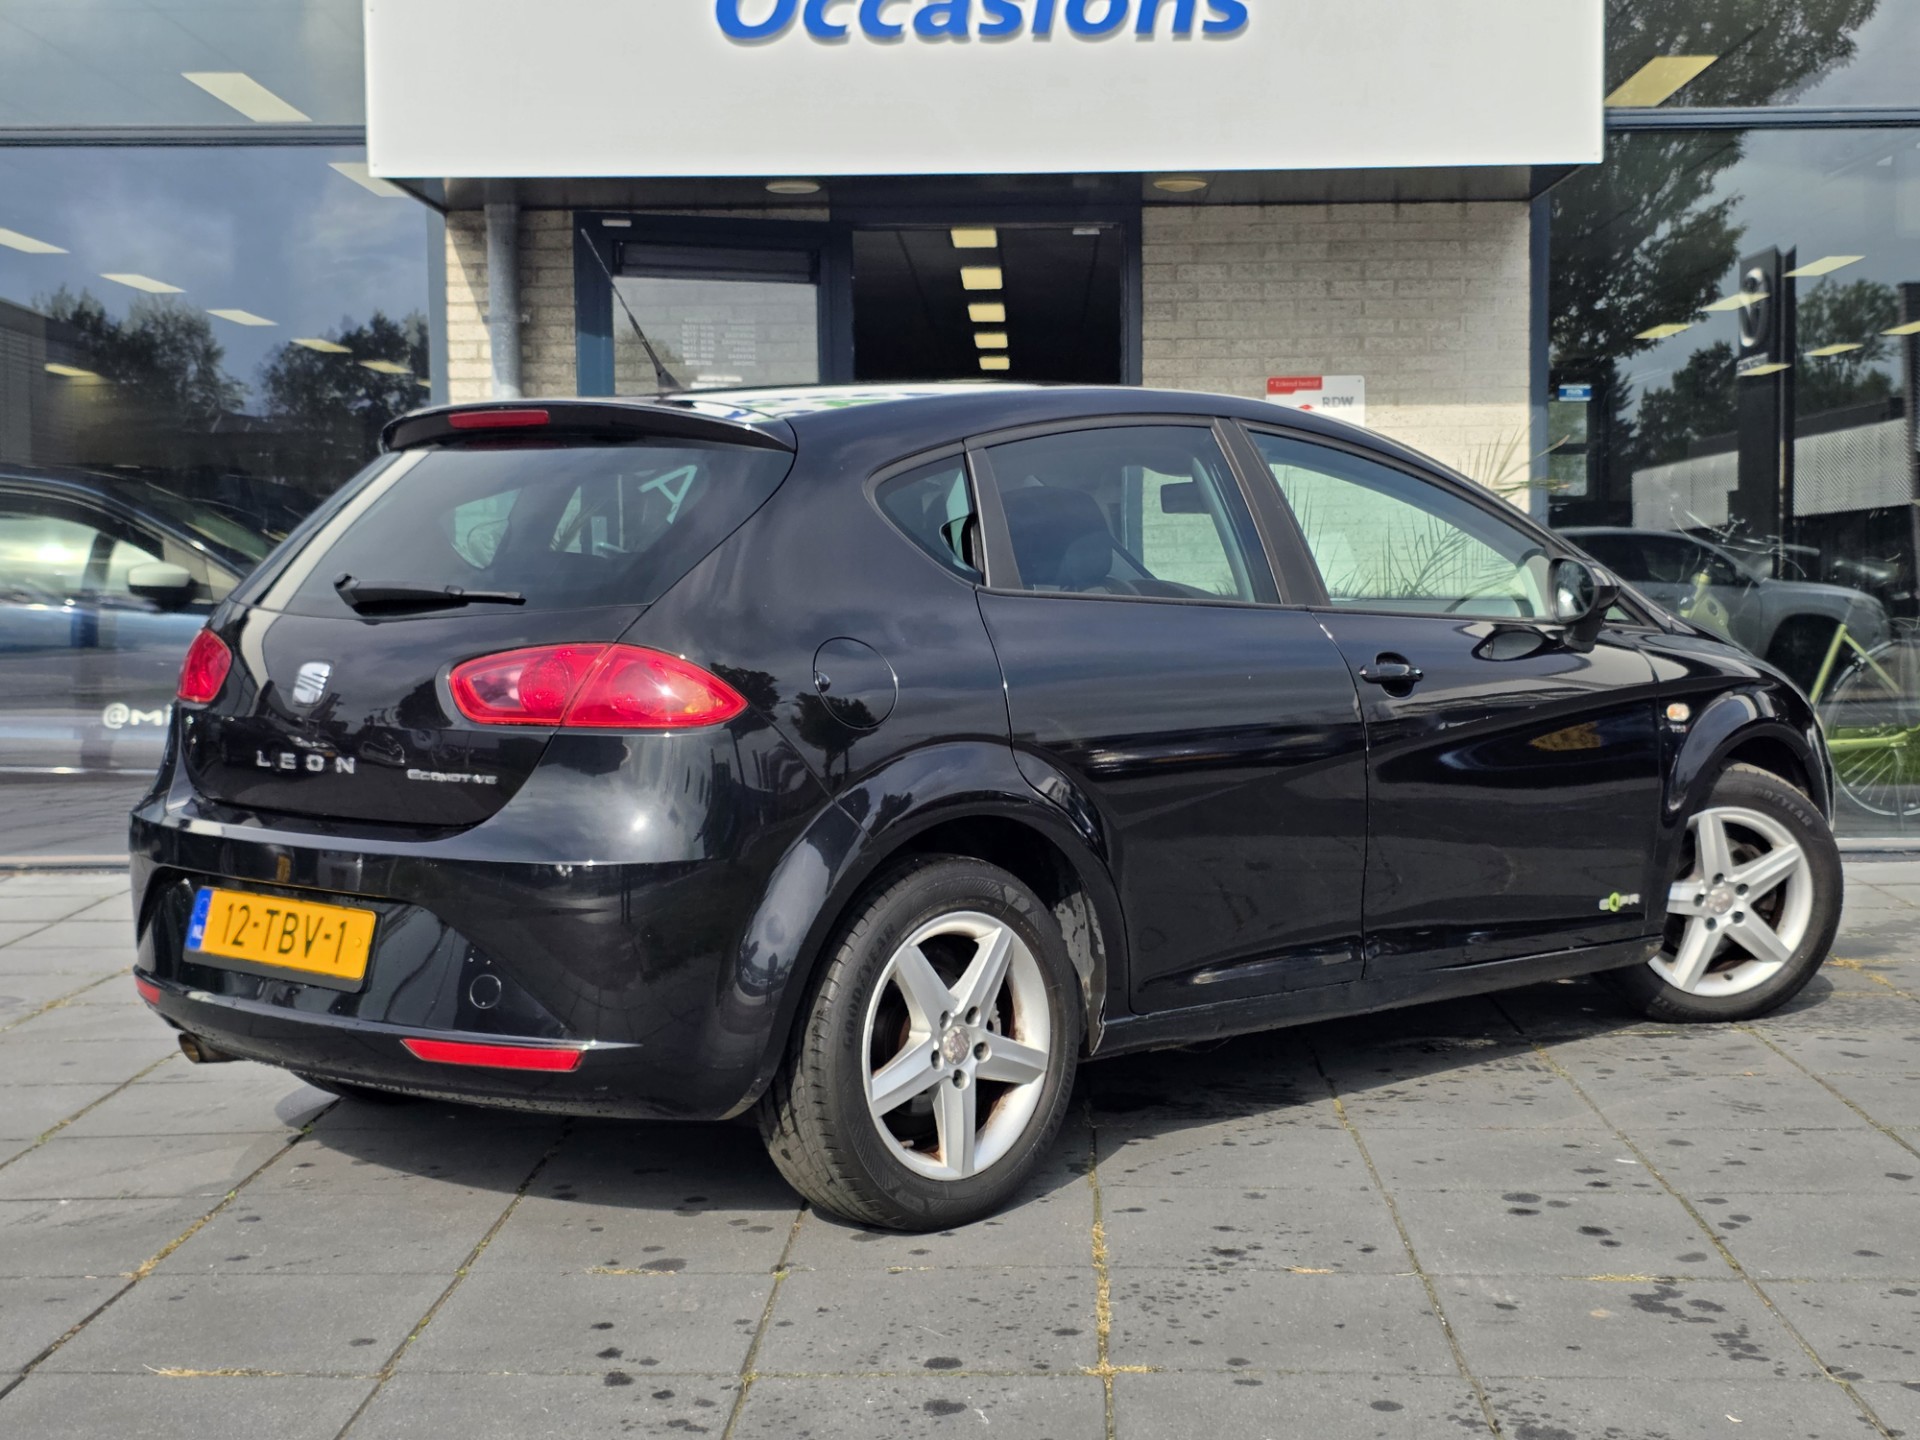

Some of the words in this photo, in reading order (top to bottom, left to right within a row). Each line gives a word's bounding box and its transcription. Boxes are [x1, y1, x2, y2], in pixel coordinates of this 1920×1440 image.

[715, 0, 1249, 41] Occasions
[1321, 396, 1355, 408] RDW
[256, 750, 355, 774] LEON
[221, 902, 348, 964] 12-TBV-1
